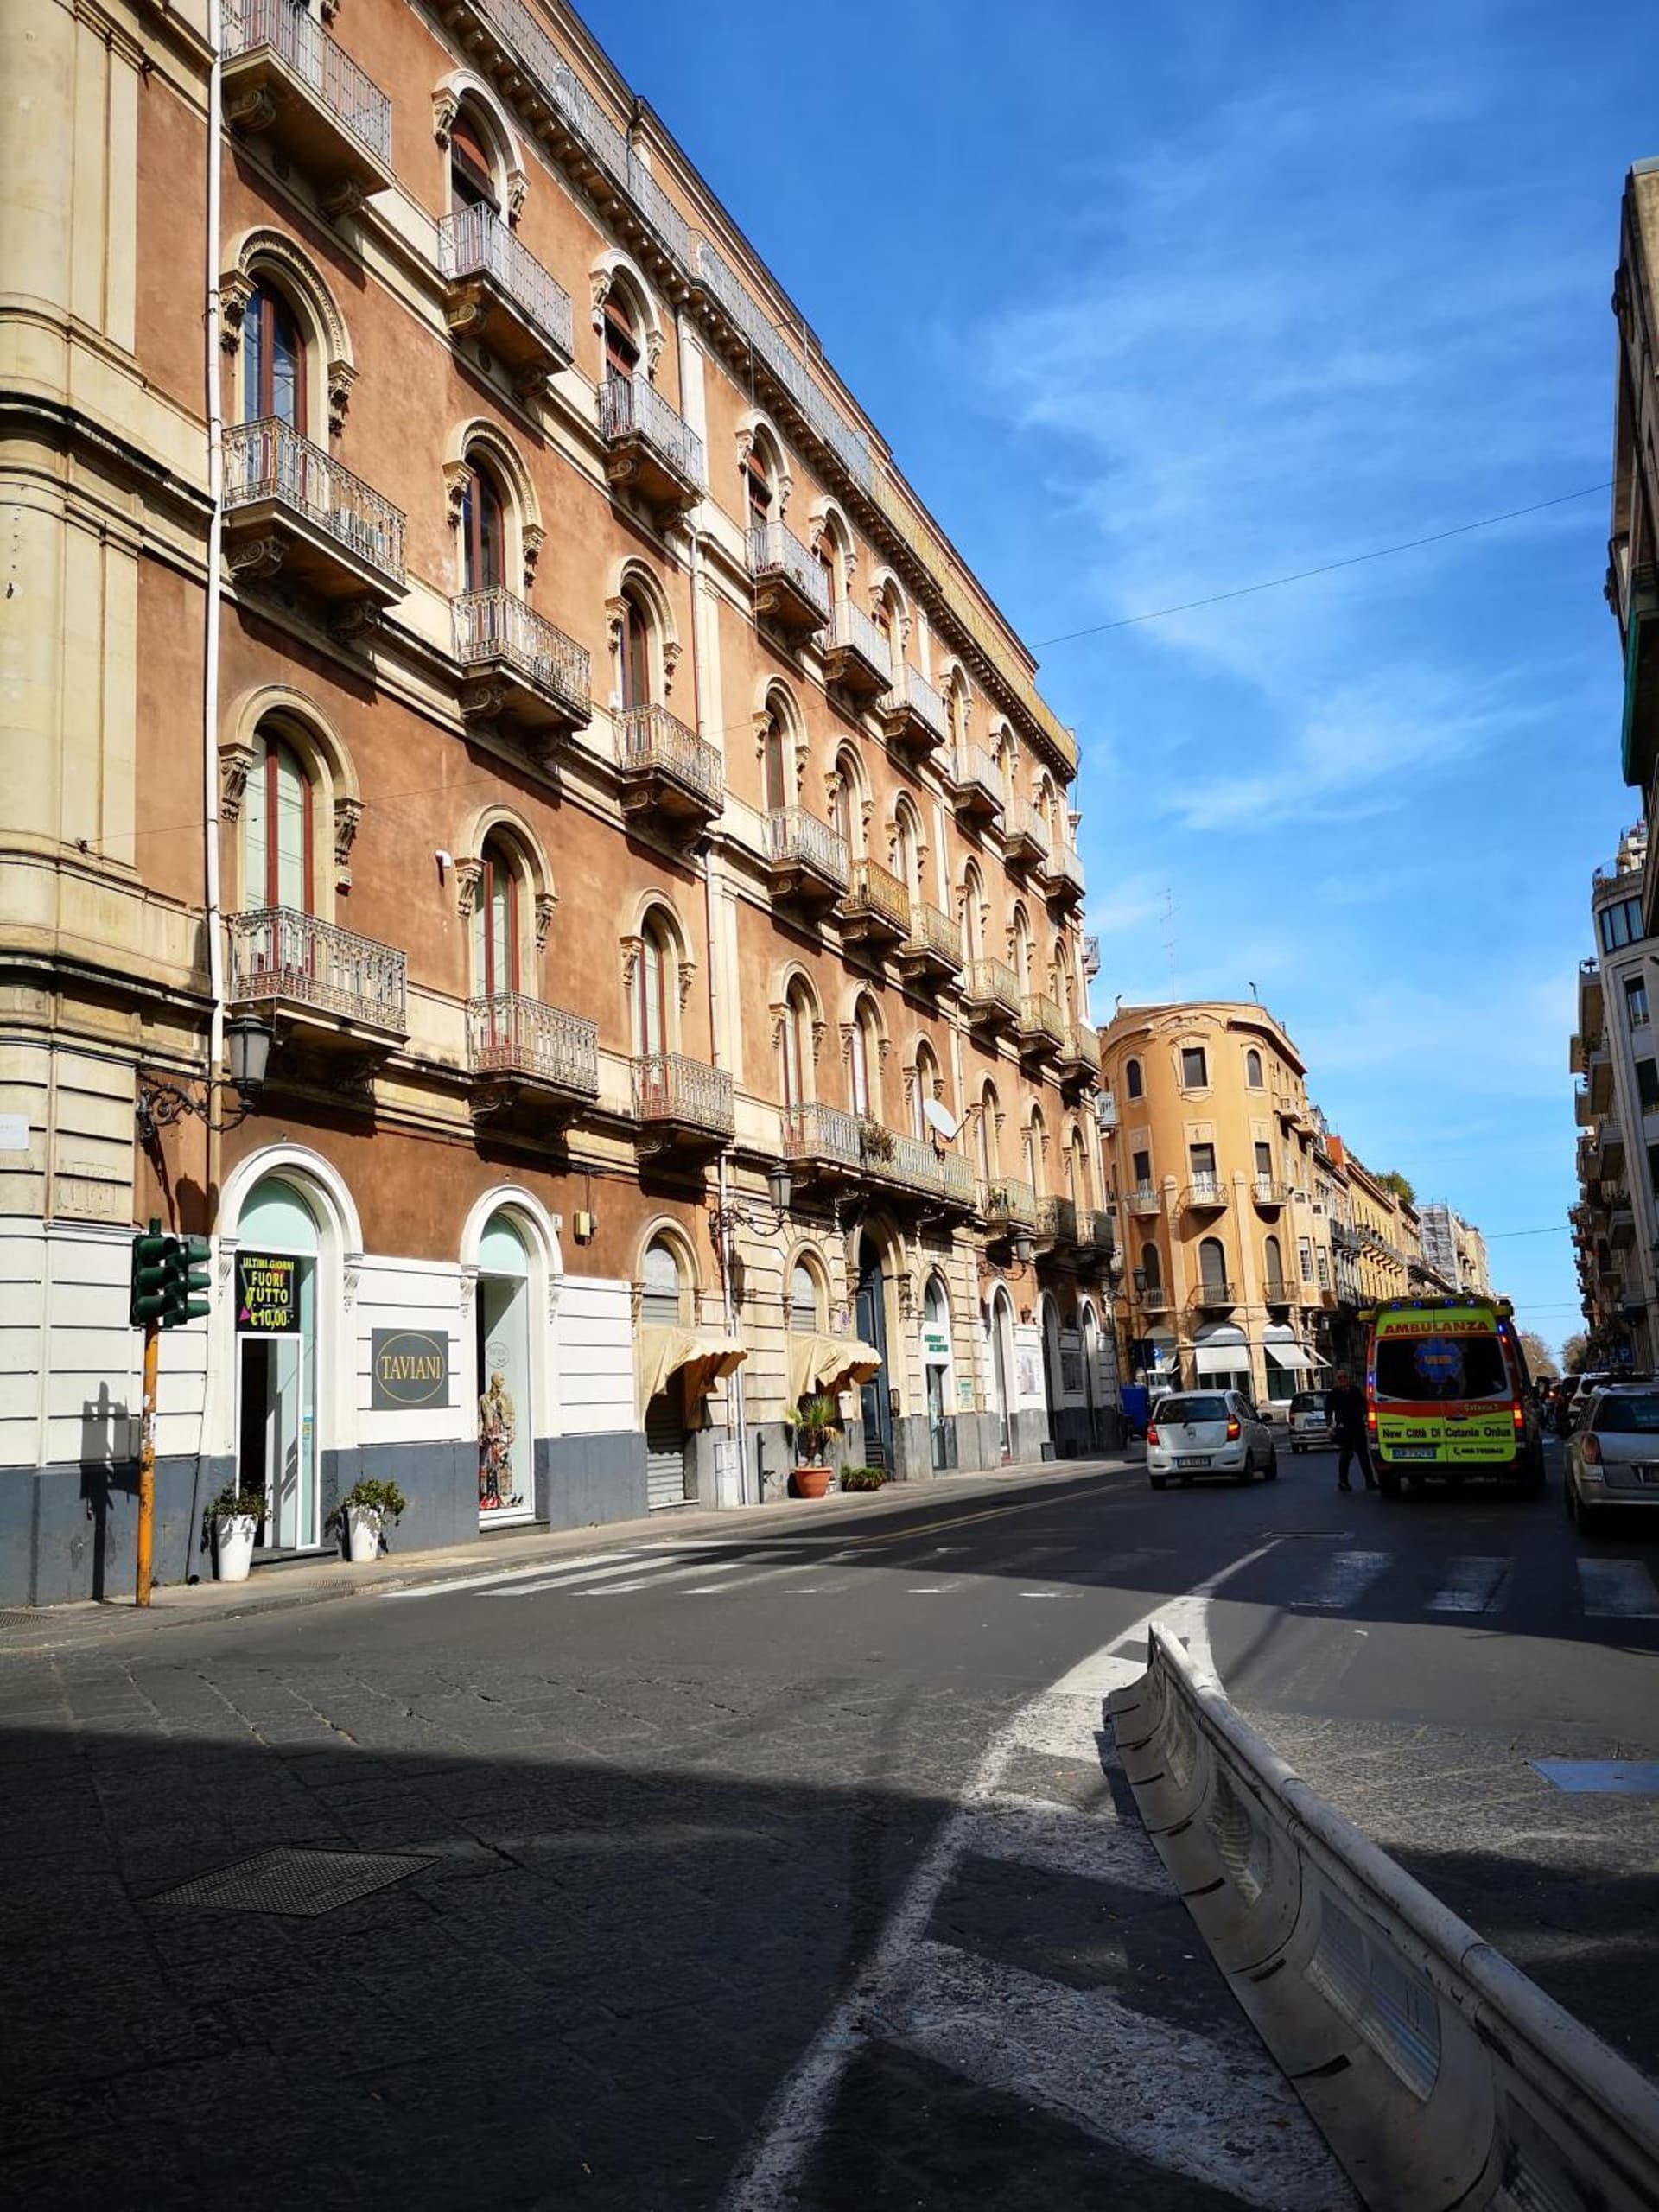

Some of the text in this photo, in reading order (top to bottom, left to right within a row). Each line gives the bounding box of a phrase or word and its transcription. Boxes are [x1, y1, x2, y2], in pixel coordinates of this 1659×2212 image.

[243, 1257, 294, 1270] ULTIMI GIORNI
[251, 1271, 284, 1287] FUORI
[248, 1287, 288, 1304] TUTTO
[1384, 1321, 1489, 1334] AMBULANZA
[381, 1356, 442, 1380] TAVIANI
[1382, 1429, 1402, 1439] New
[1406, 1428, 1427, 1439] Città
[1431, 1428, 1440, 1438] Di
[1446, 1427, 1479, 1438] Catania
